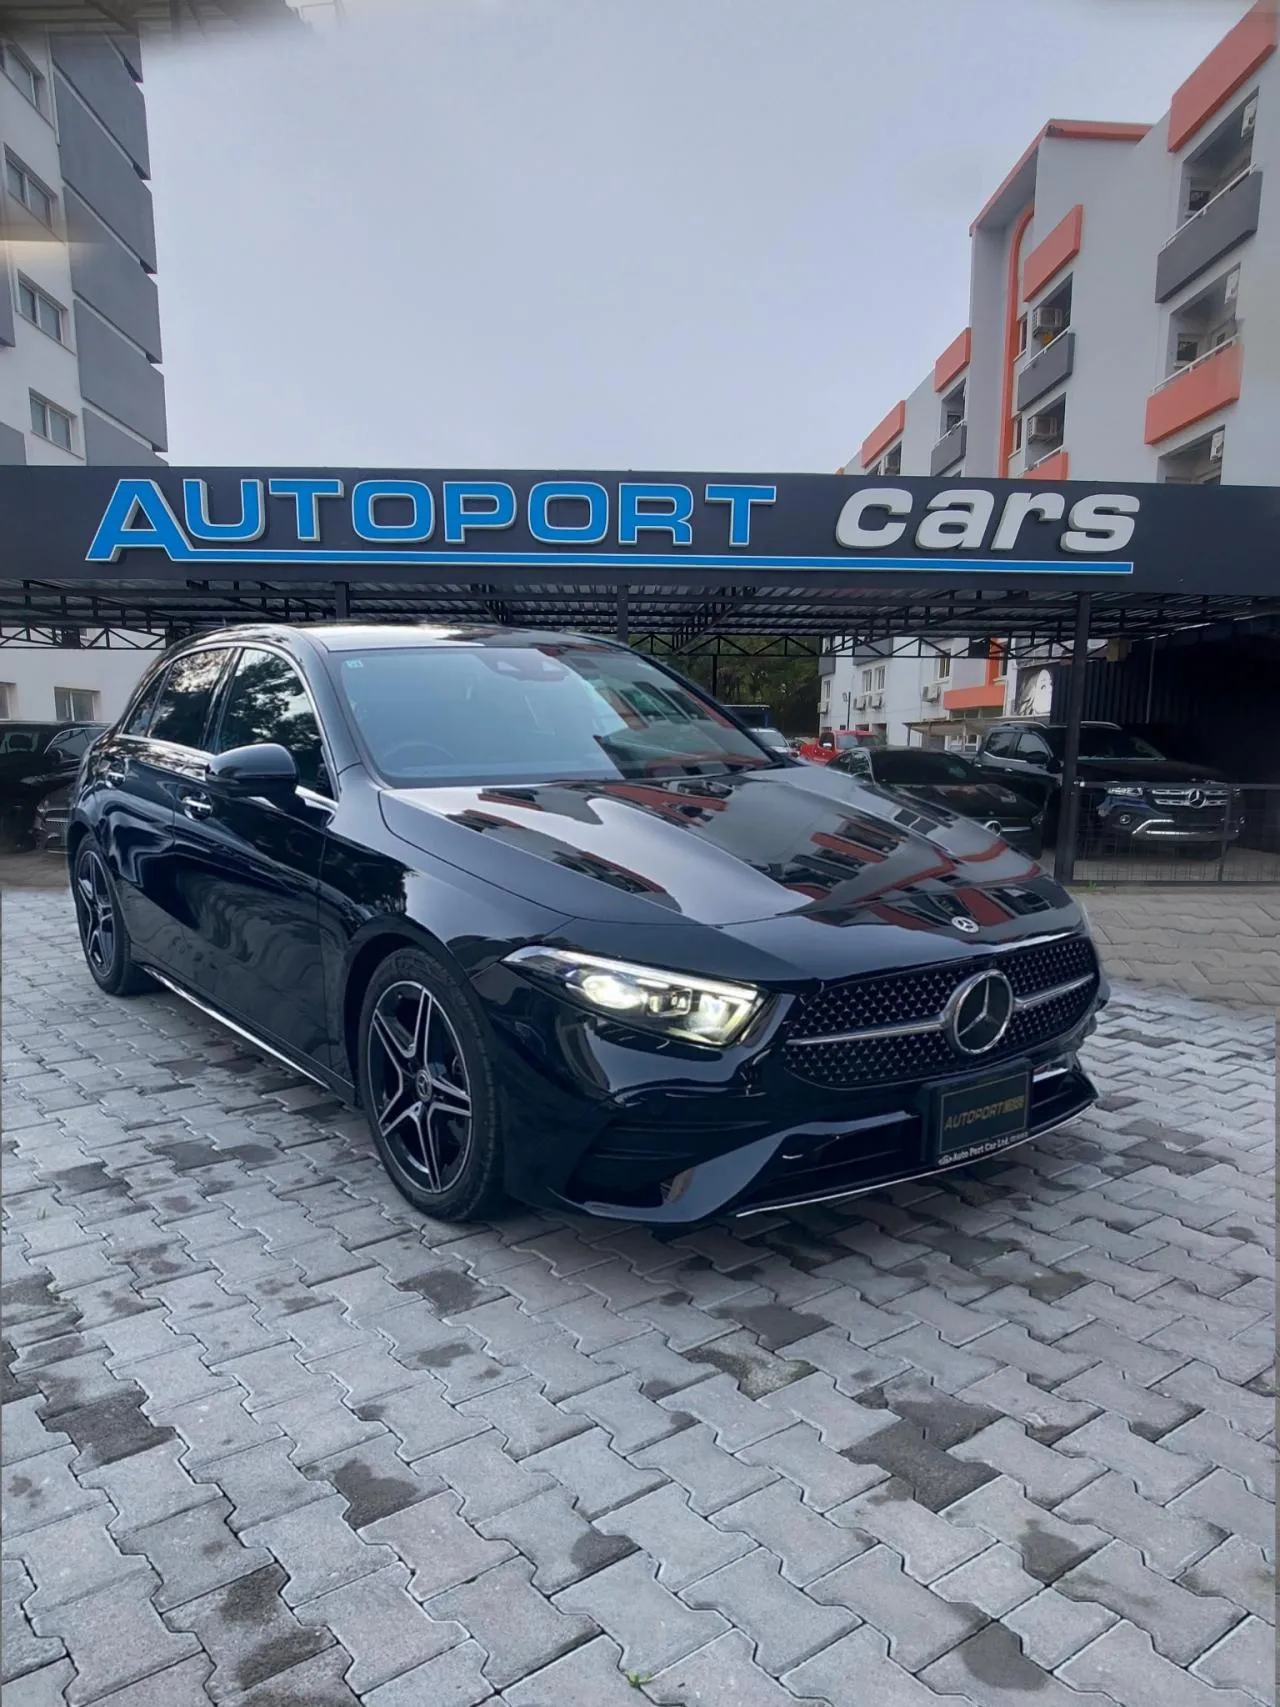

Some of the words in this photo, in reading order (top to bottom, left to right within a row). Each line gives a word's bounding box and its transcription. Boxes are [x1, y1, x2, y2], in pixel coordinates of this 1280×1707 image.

[85, 478, 777, 562] AUTOPORT
[834, 486, 1141, 554] cars
[944, 1102, 1005, 1130] AUTOPORT
